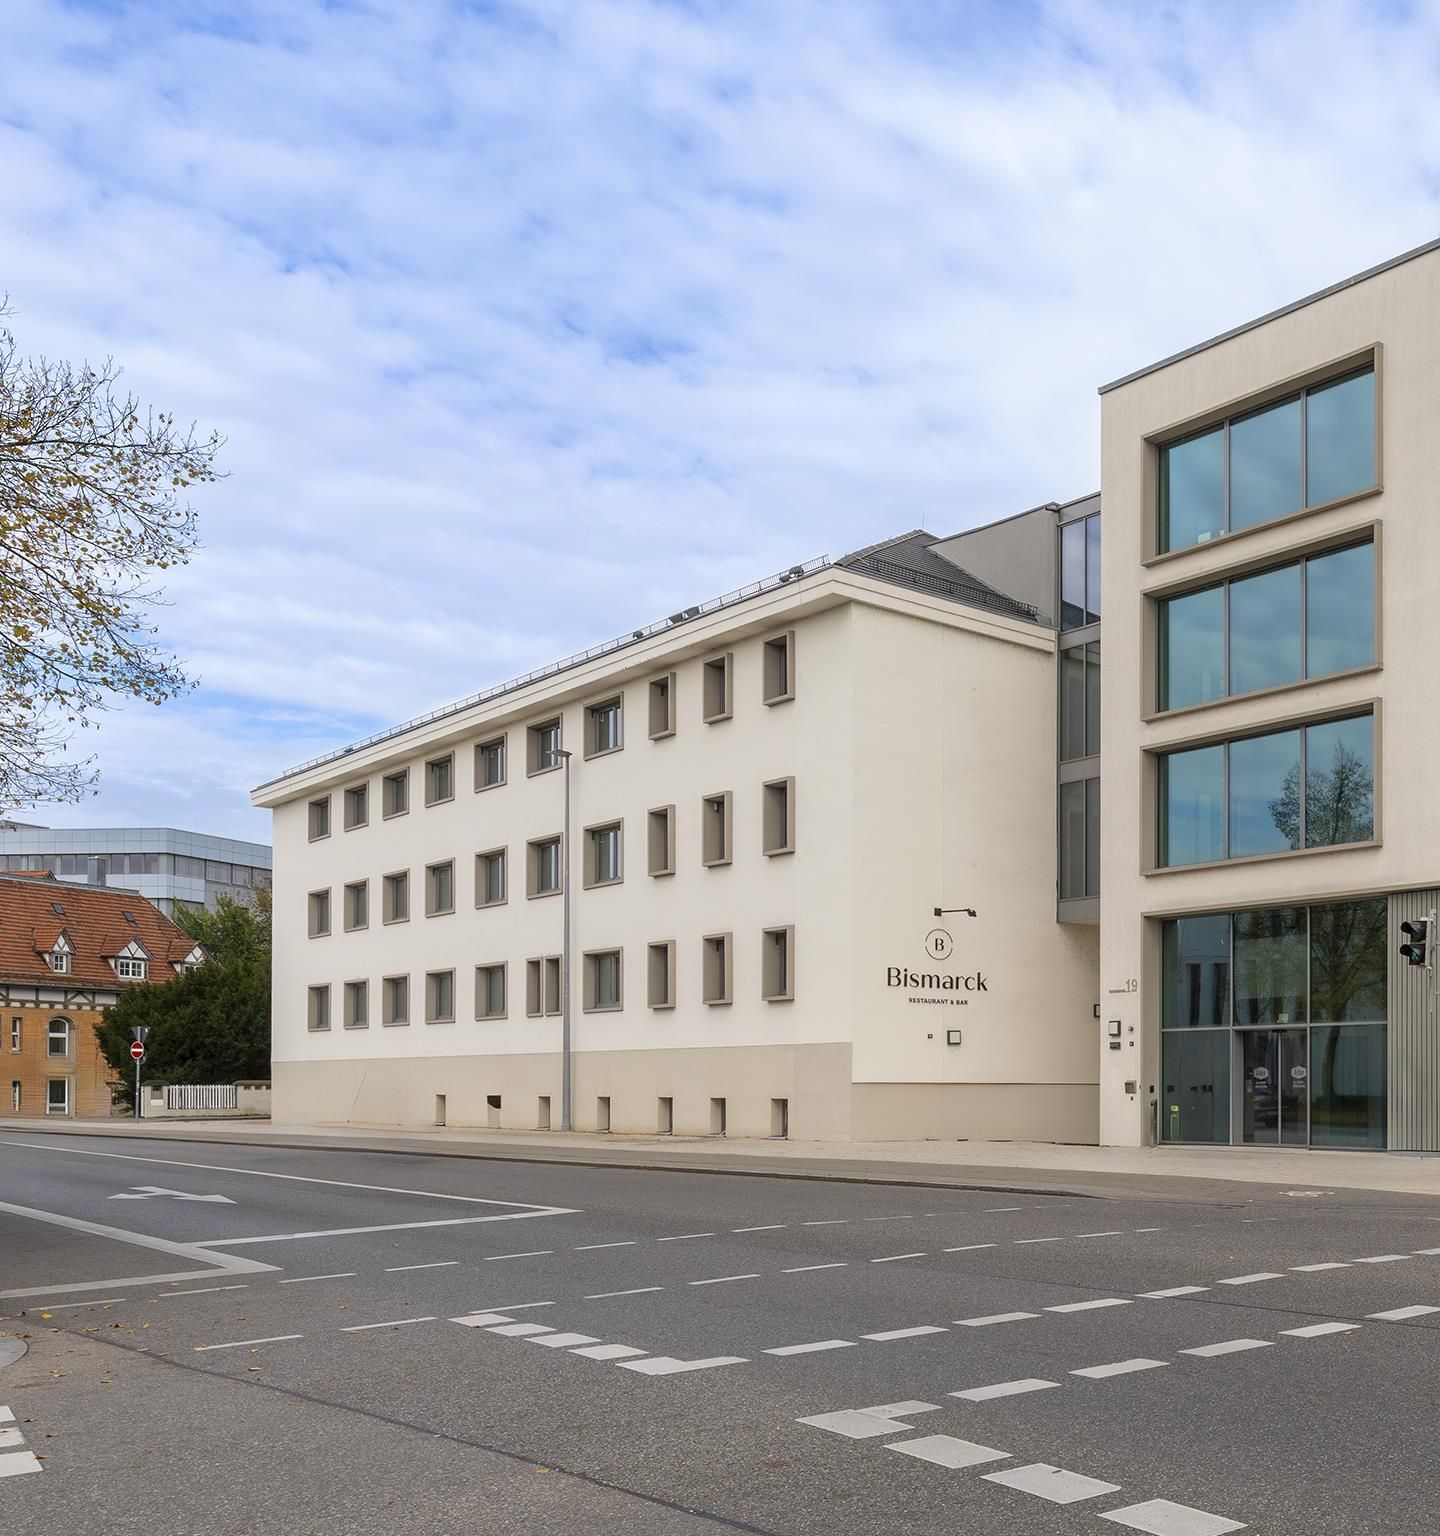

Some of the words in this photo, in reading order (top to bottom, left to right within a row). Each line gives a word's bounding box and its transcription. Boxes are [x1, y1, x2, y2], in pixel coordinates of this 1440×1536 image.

[935, 937, 945, 951] B
[886, 966, 988, 992] Bismarck
[1125, 978, 1138, 993] 19
[908, 997, 949, 1005] RESTAURANT
